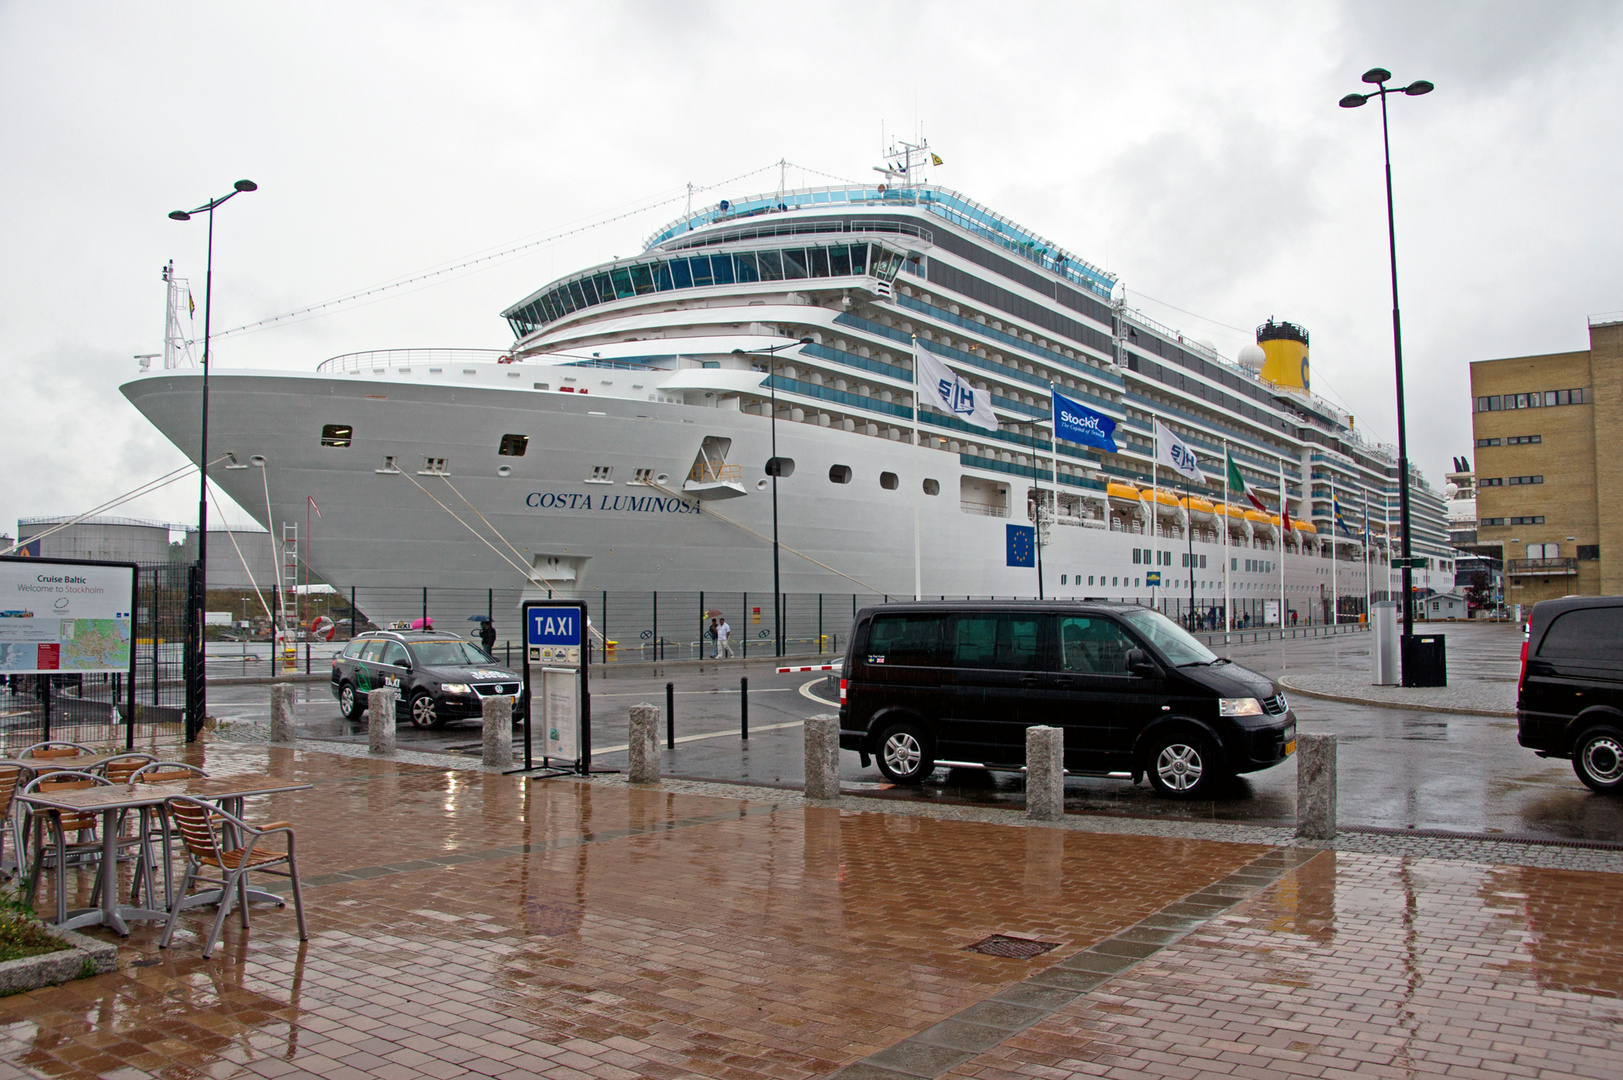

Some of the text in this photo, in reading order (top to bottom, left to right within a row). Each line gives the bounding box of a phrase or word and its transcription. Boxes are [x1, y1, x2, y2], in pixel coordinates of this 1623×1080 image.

[525, 492, 702, 515] COSTA LUMINOSA
[37, 574, 87, 585] Cruise Baltic
[17, 583, 104, 594] Welcome to Stockholm
[392, 622, 411, 630] TAXI
[535, 616, 573, 636] TAXI
[384, 676, 400, 688] TAXI
